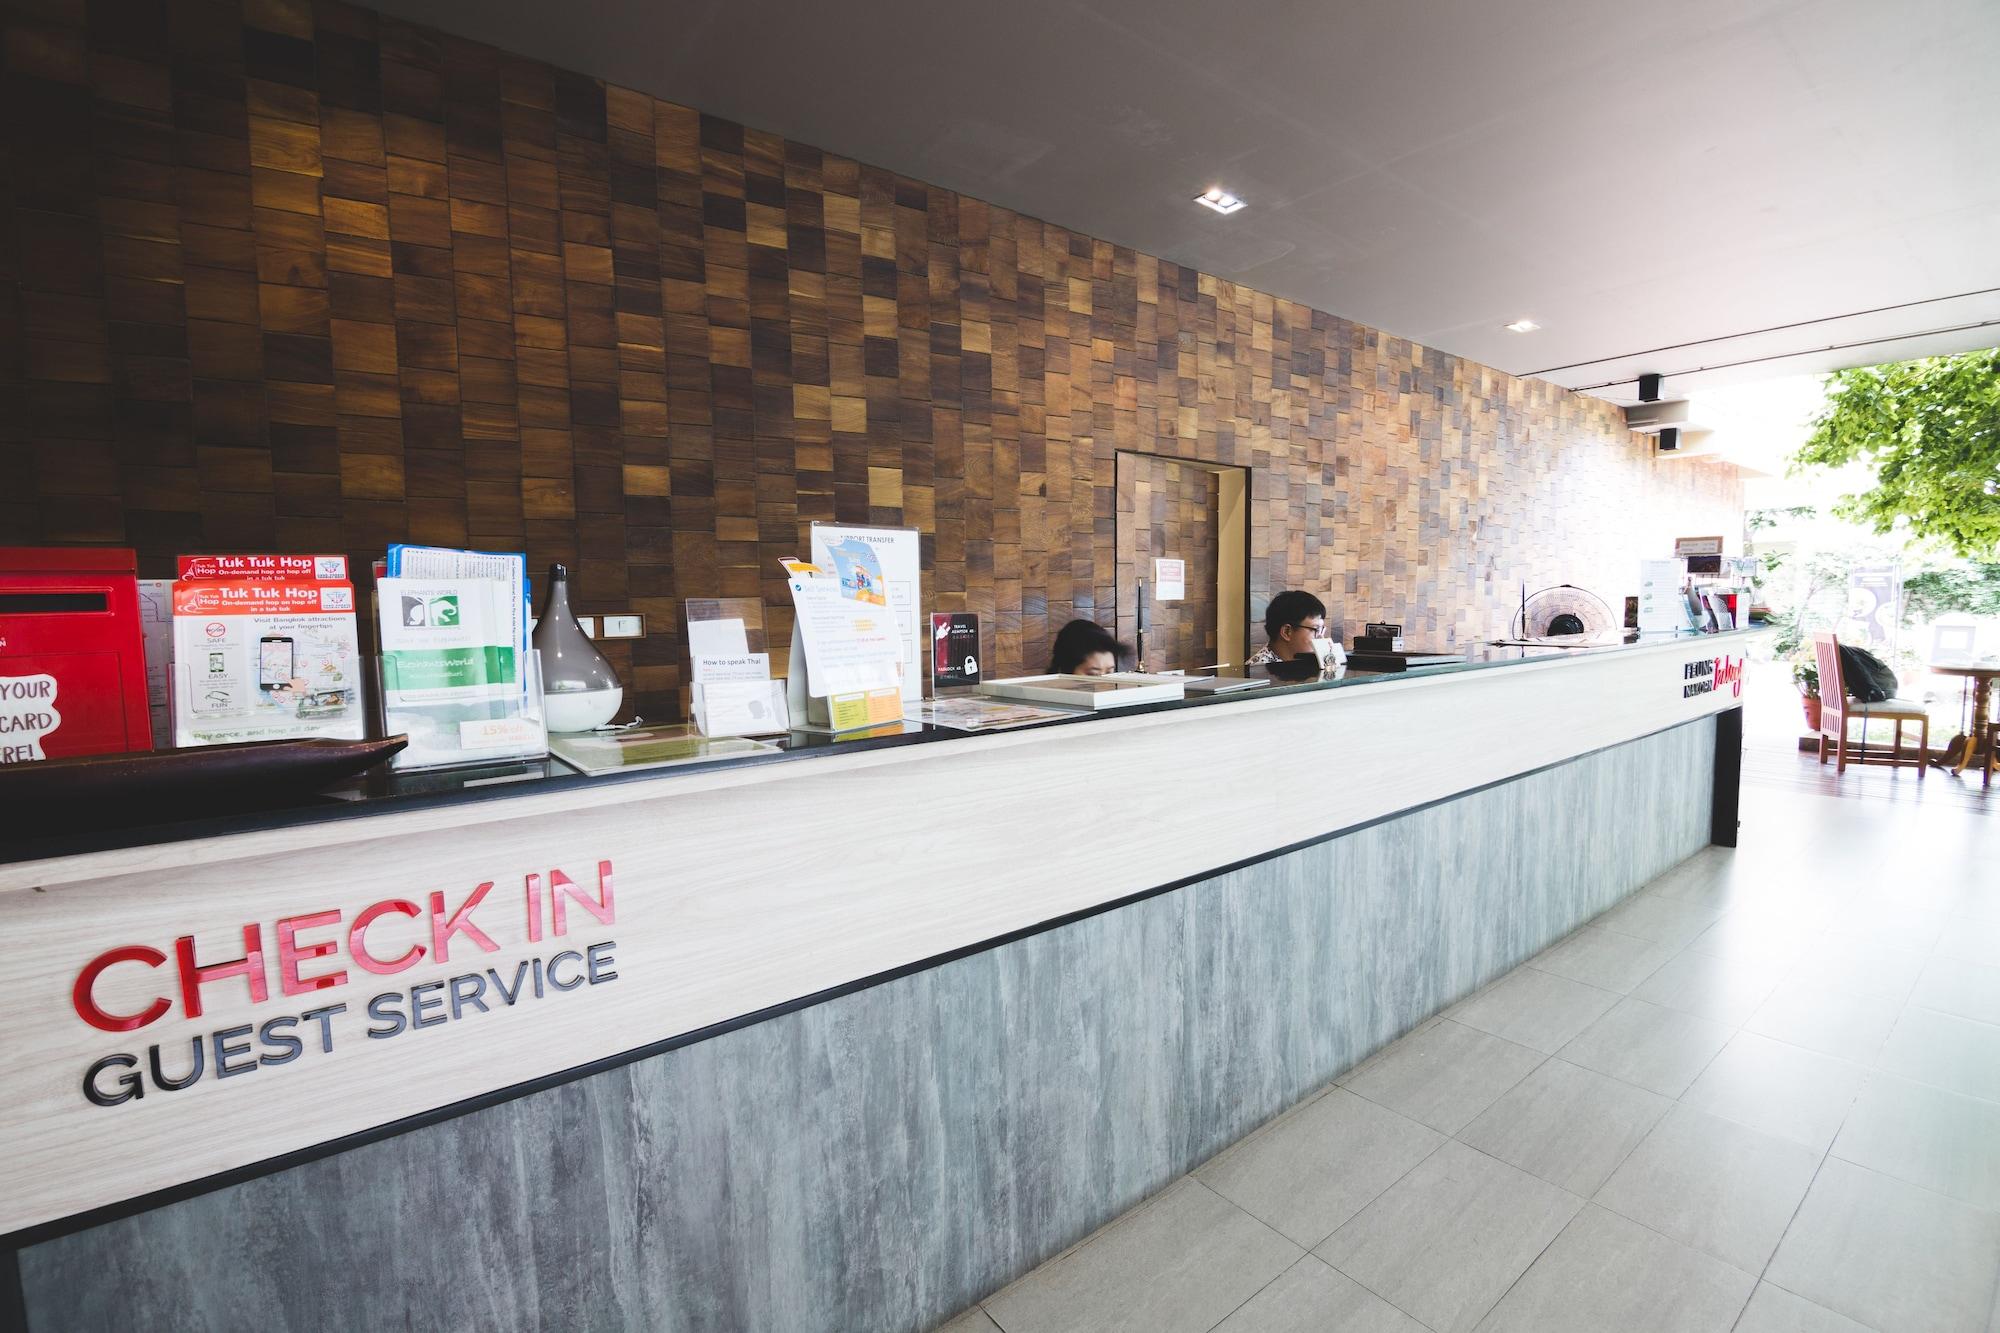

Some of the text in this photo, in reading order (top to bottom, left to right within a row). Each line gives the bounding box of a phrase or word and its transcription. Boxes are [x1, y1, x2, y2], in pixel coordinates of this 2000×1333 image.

[216, 556, 312, 569] Tuk Tuk Hop
[218, 587, 318, 600] Tuk Tuk Hop
[273, 616, 305, 624] Bangkok
[727, 658, 746, 666] speak
[0, 680, 51, 700] YOUR
[0, 712, 52, 734] CARD
[194, 732, 212, 740] Pay
[247, 728, 264, 736] and
[268, 728, 286, 736] hop
[0, 744, 34, 764] RE!
[72, 860, 616, 1032] CHECK IN
[82, 940, 618, 1106] GUEST SERVICE
